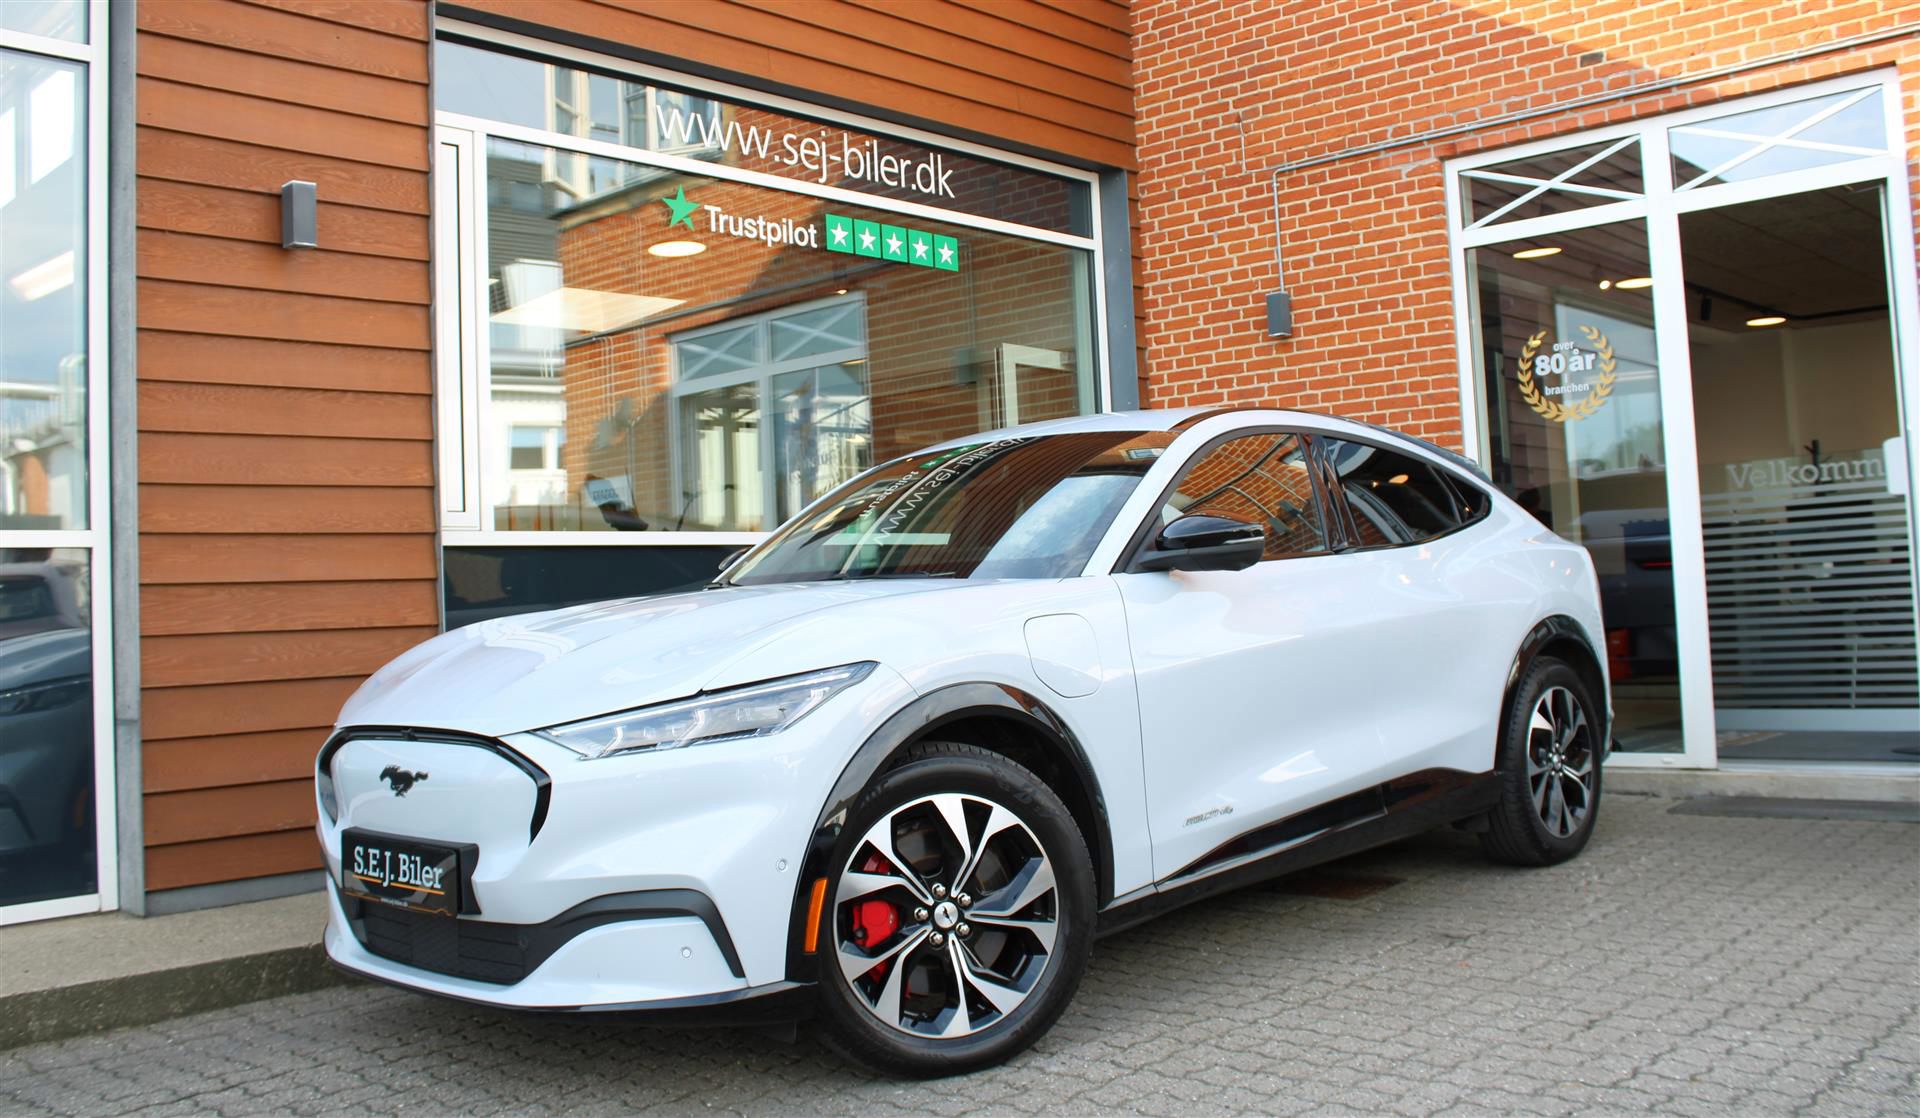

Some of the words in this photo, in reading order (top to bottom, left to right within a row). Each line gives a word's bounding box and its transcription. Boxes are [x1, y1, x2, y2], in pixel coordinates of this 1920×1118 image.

[656, 104, 955, 198] www.sej-biler.dk
[704, 204, 817, 248] Trustpilot
[1553, 341, 1575, 351] over
[1535, 353, 1565, 376] 80
[1569, 348, 1596, 372] år
[1545, 383, 1589, 396] branchen
[1725, 458, 1886, 489] Velkomm
[354, 845, 394, 887] S.E.J.
[398, 853, 443, 889] Biler
